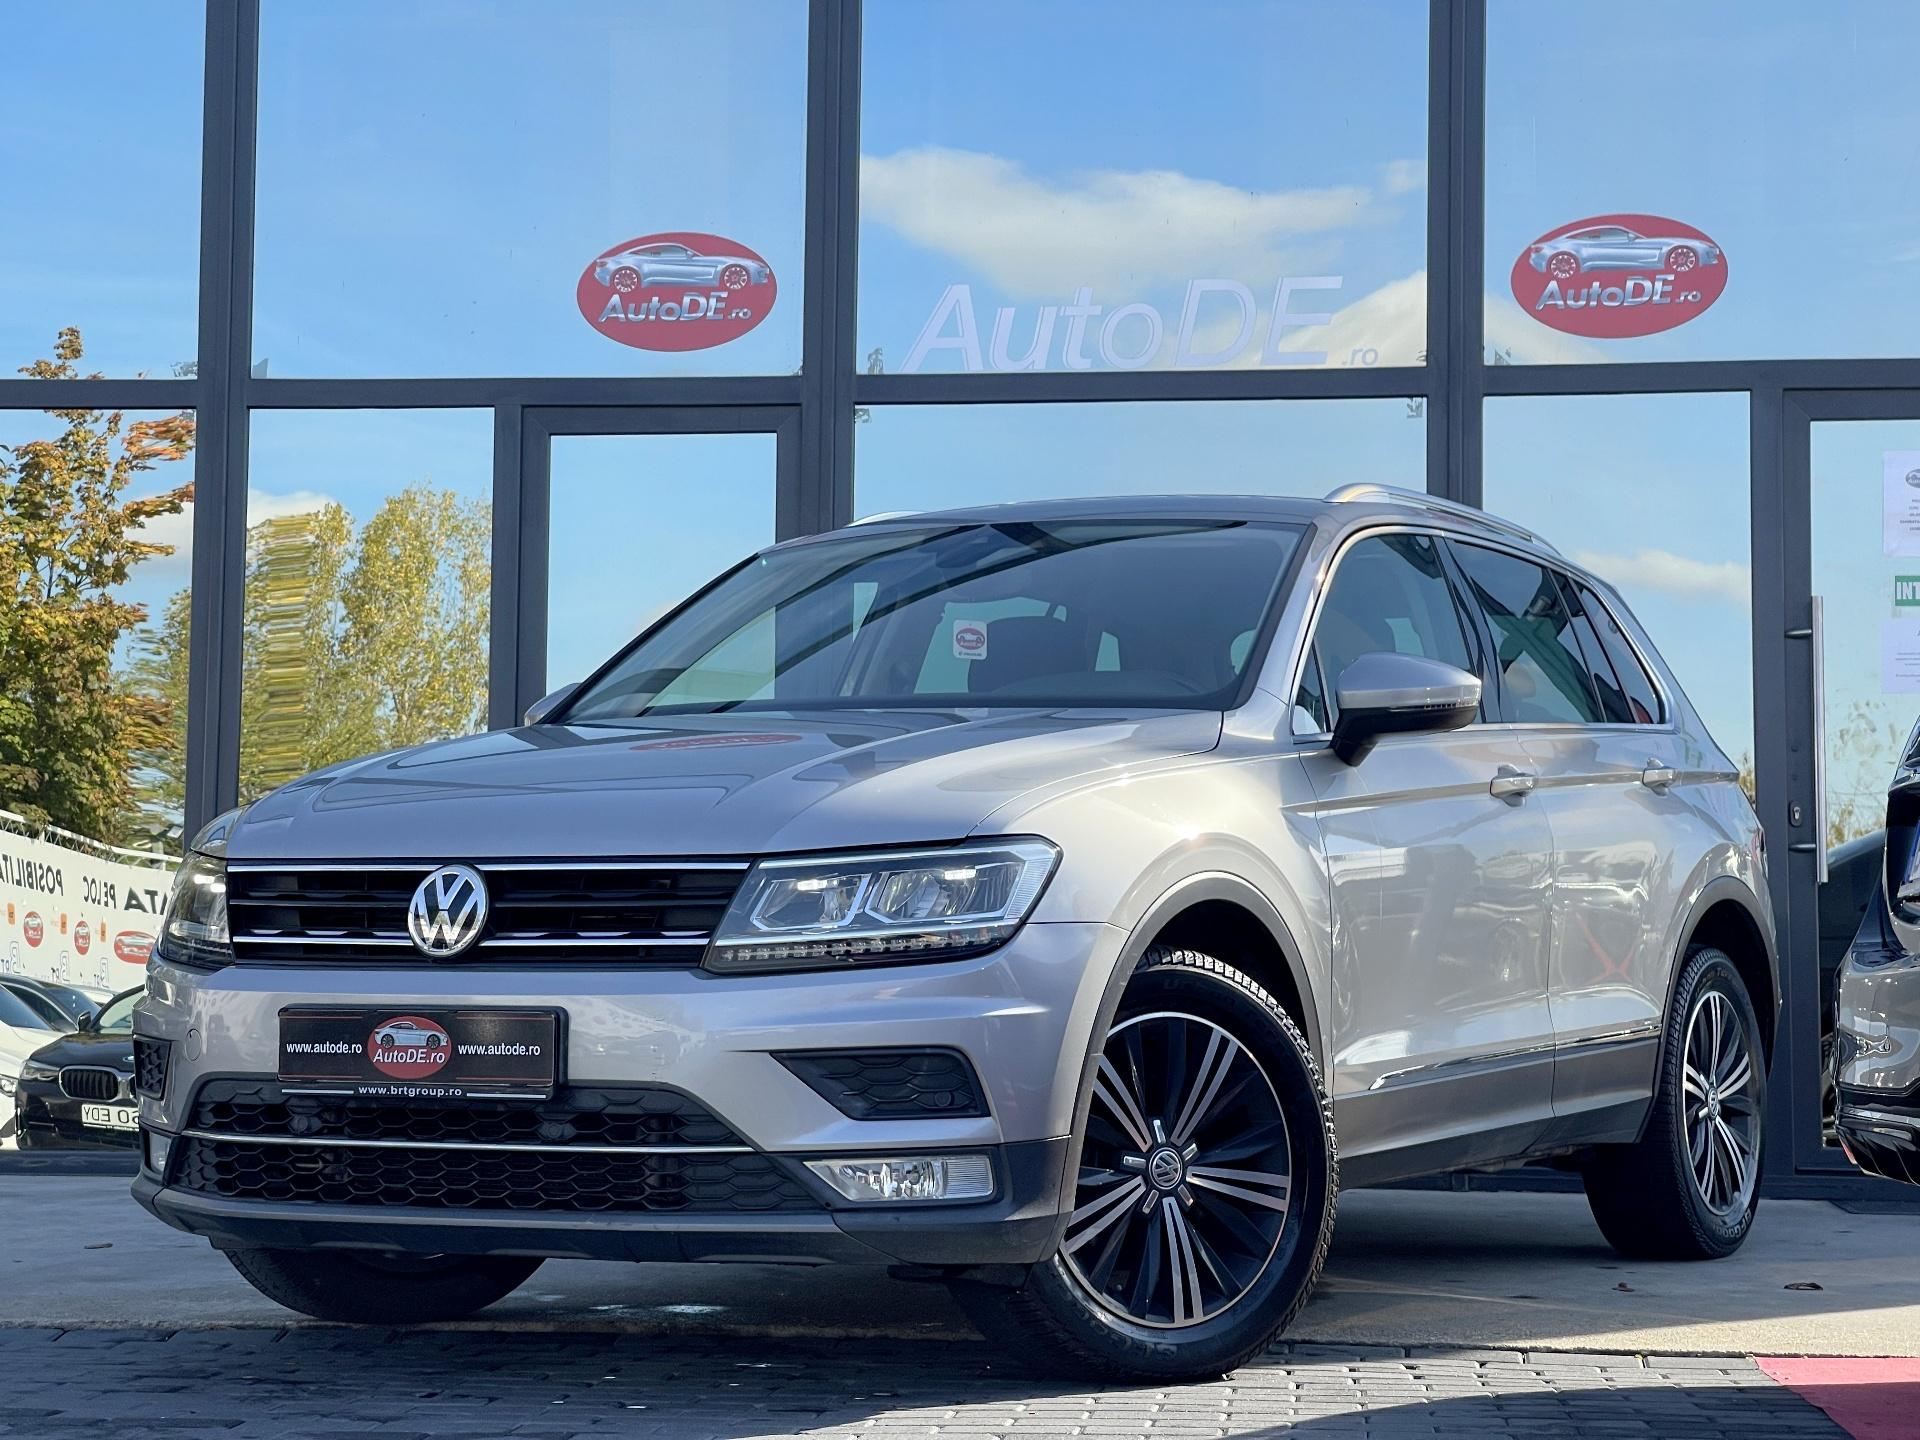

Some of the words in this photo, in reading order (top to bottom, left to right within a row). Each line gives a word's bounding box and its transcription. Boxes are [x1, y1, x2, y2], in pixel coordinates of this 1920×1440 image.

[286, 1040, 363, 1055] www.autode.ro
[457, 1042, 541, 1057] www.autode.ro
[372, 1048, 446, 1065] AutoDE.ro
[358, 1085, 463, 1099] www.brtgroup.ro
